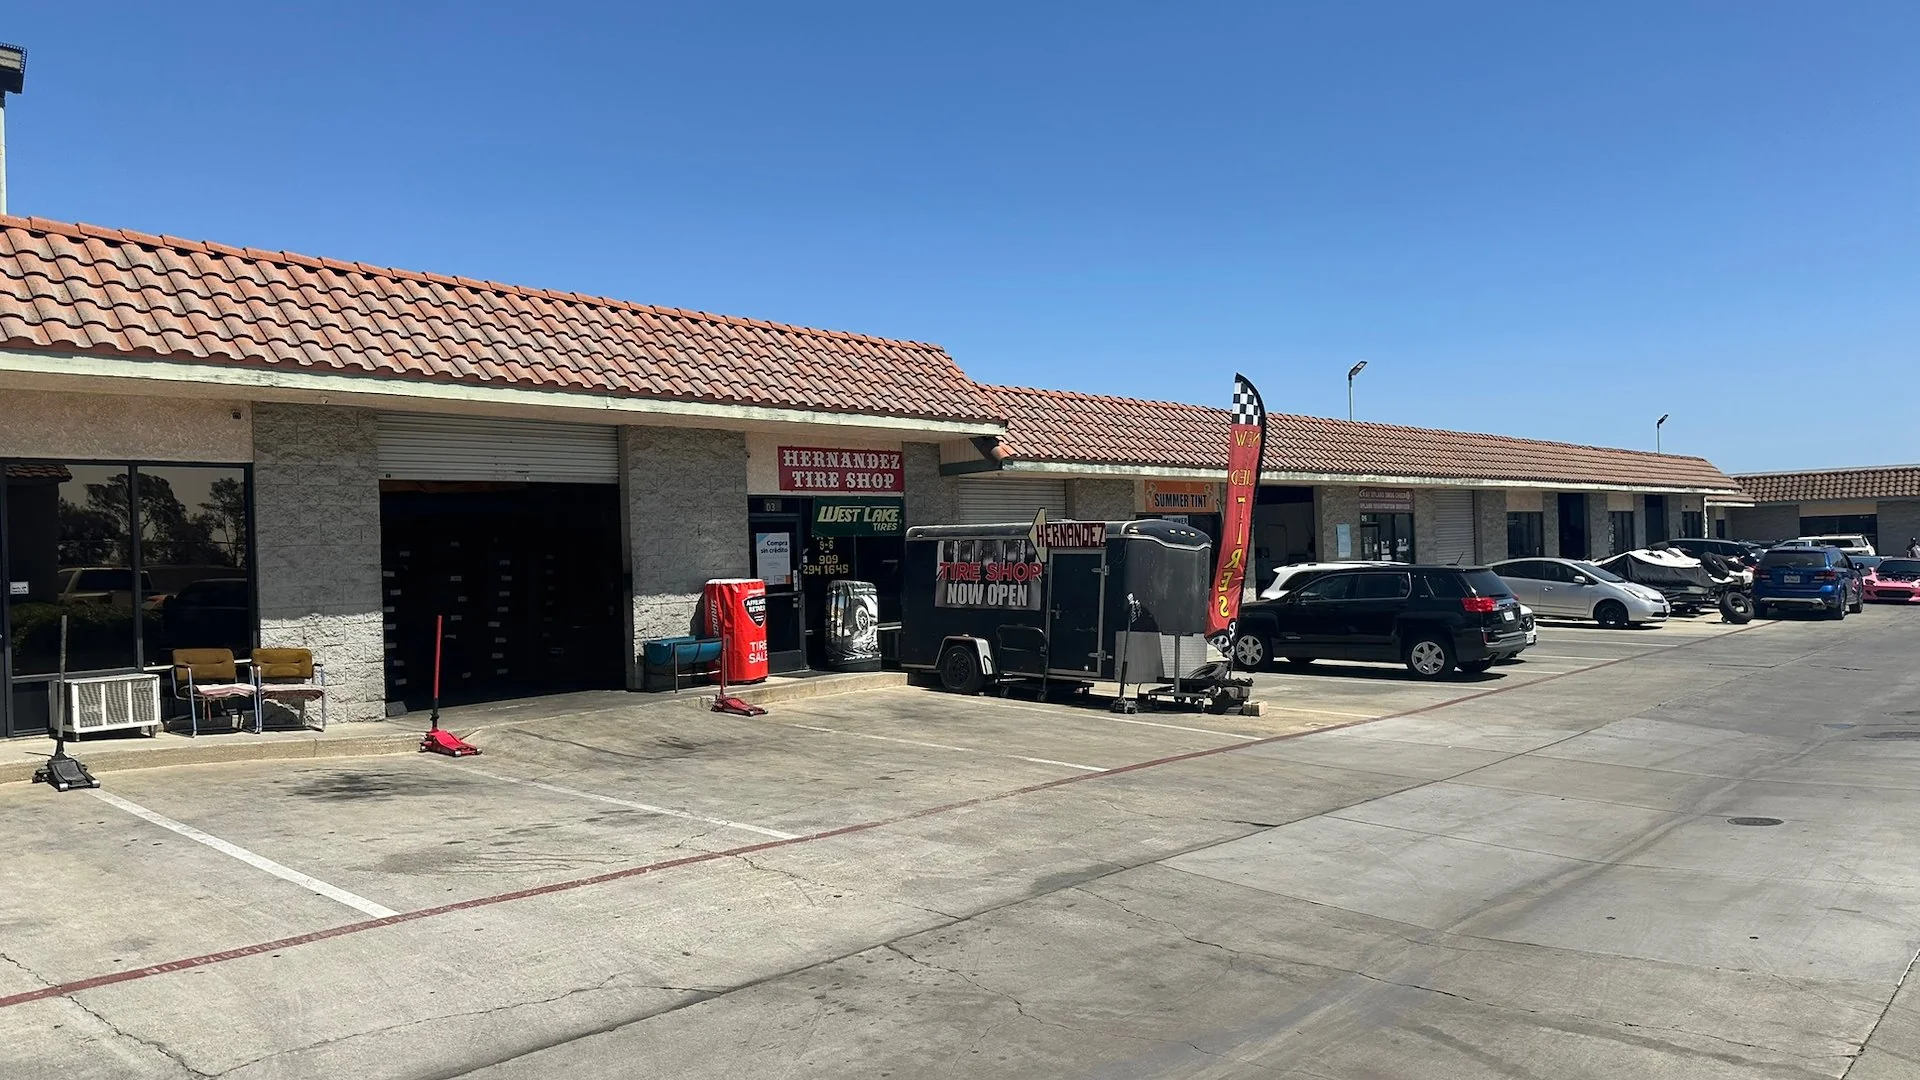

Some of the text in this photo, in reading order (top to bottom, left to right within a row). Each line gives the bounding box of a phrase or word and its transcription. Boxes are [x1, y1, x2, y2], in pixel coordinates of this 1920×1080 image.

[783, 449, 900, 470] HERNANDEZ
[792, 471, 895, 489] TIRE SHOP
[1154, 493, 1207, 508] SUMMER TINT
[817, 506, 900, 523] WEST LAKE
[873, 522, 898, 531] TIRES
[1036, 523, 1107, 548] HERNANDEZ
[818, 554, 839, 565] 909
[803, 564, 849, 575] 294 1645
[940, 562, 1043, 582] TIRE SHOP
[947, 584, 1028, 607] NOW OPEN
[749, 640, 767, 652] TIRE
[748, 651, 769, 664] SALE
